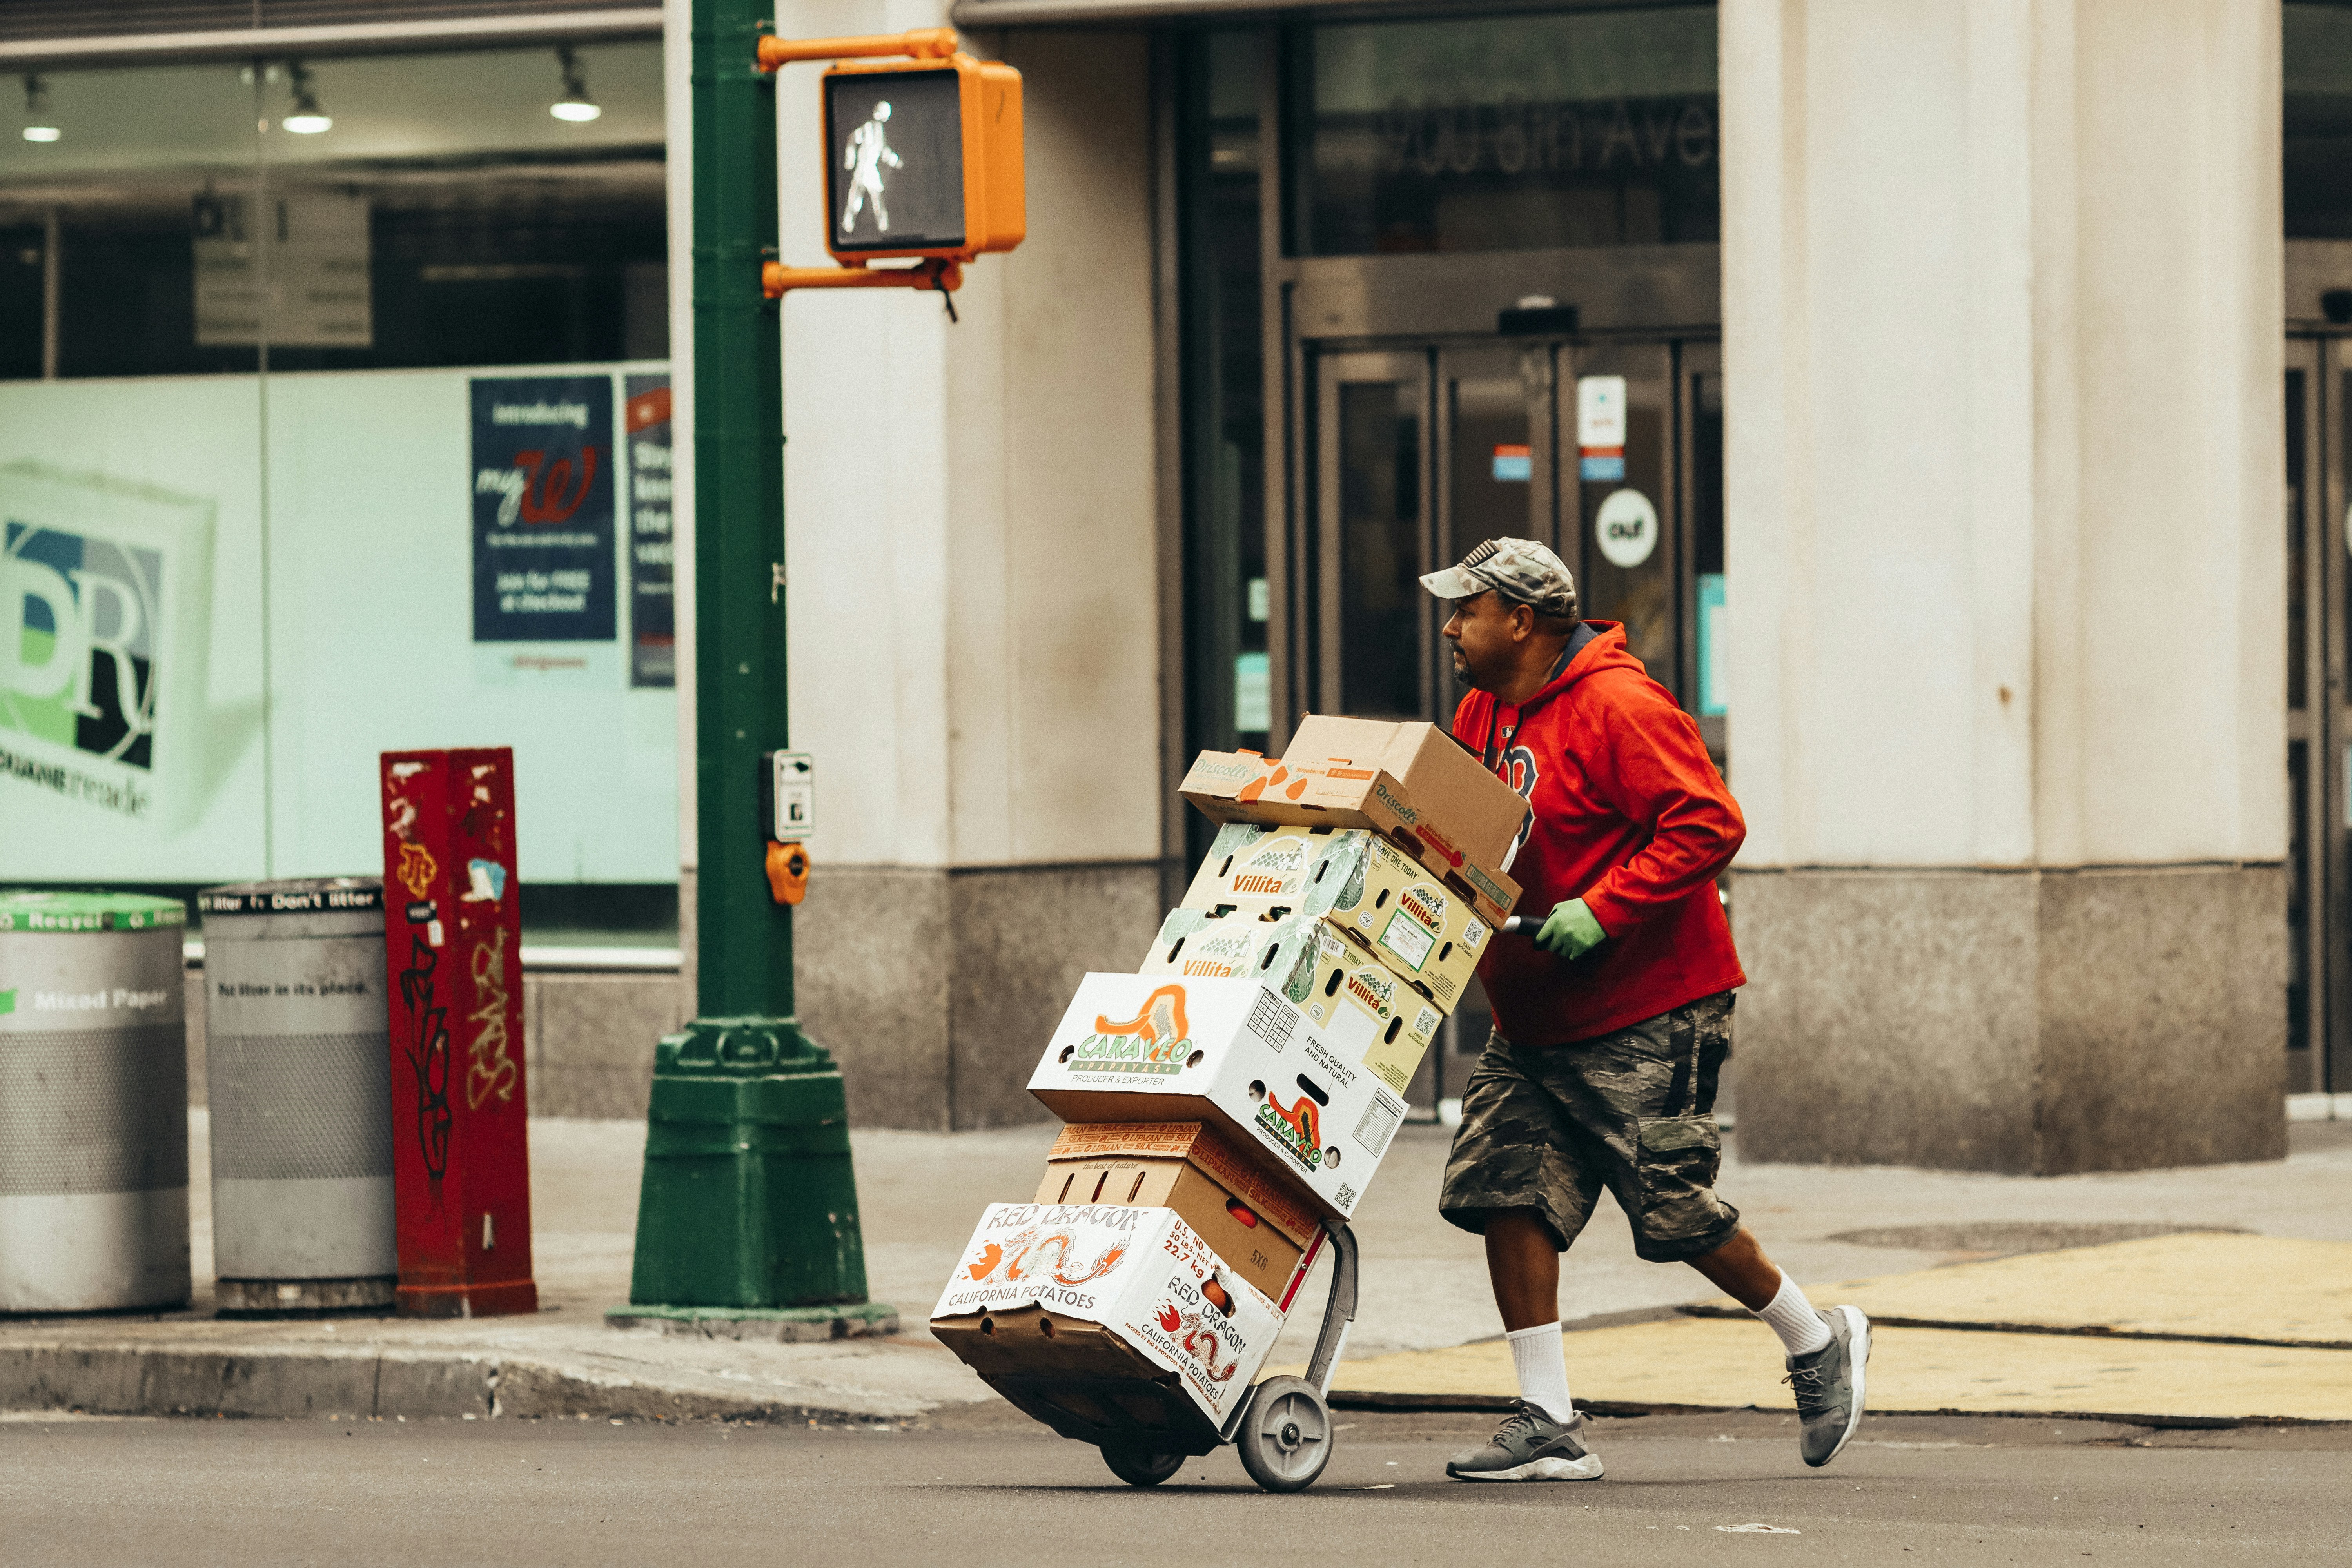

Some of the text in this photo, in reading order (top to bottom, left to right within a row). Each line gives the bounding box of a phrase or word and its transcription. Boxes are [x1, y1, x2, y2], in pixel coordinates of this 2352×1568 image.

[1192, 759, 1250, 779] Driscoll's
[1376, 784, 1418, 824] Driscoll's
[1390, 855, 1402, 867] ONE
[1401, 862, 1418, 880] TODAY
[1233, 875, 1282, 893] Villita
[272, 894, 321, 909] Don't
[330, 893, 373, 907] litter
[1401, 893, 1432, 926] Villita
[1457, 943, 1473, 958] AVOCADOS
[1463, 942, 1471, 951] HASS
[1183, 960, 1231, 977] Villita
[1347, 951, 1362, 967] TODAY
[35, 990, 107, 1011] Mixed
[1348, 976, 1380, 1010] Villita
[1284, 1008, 1297, 1020] COUNT
[1408, 1033, 1425, 1048] AVOCADOS
[1414, 1032, 1423, 1040] HASS
[1078, 1034, 1192, 1063] CARAVEO
[1307, 1036, 1329, 1058] FRESH
[1329, 1056, 1357, 1081] QUALITY
[1087, 1062, 1160, 1073] PAPAYAS
[1304, 1047, 1348, 1089] AND NATURAL
[1071, 1074, 1114, 1083] PRODUCER
[1122, 1076, 1165, 1085] EXPORTER
[1377, 1091, 1401, 1114] Nutrition Facts
[1259, 1104, 1322, 1163] CARAVEO
[1265, 1125, 1305, 1162] PAPAYAS
[1091, 1144, 1123, 1152] LIPMAN
[1256, 1126, 1281, 1150] PRODUCER
[1284, 1151, 1307, 1174] EXPORTER
[1093, 1161, 1106, 1169] best
[1107, 1161, 1118, 1172] of
[1199, 1151, 1234, 1184] LIPMAN
[1248, 1188, 1269, 1210] SILK
[986, 1205, 1149, 1230] RED DRAGON
[1170, 1231, 1180, 1241] 50
[1181, 1240, 1194, 1254] LBS.
[1197, 1252, 1209, 1266] NET
[1174, 1220, 1212, 1260] U.S. NO. 1
[1163, 1240, 1204, 1279] 22.7 kg
[1250, 1249, 1269, 1271] 5X6
[949, 1287, 1018, 1306] CALIFORNIA
[1248, 1287, 1265, 1305] PRODUCE
[1168, 1276, 1247, 1354] RED DRAGON
[1125, 1323, 1141, 1336] PACKED
[1158, 1348, 1178, 1367] POTATOES
[1142, 1324, 1219, 1399] CALIFORNIA POTATOES
